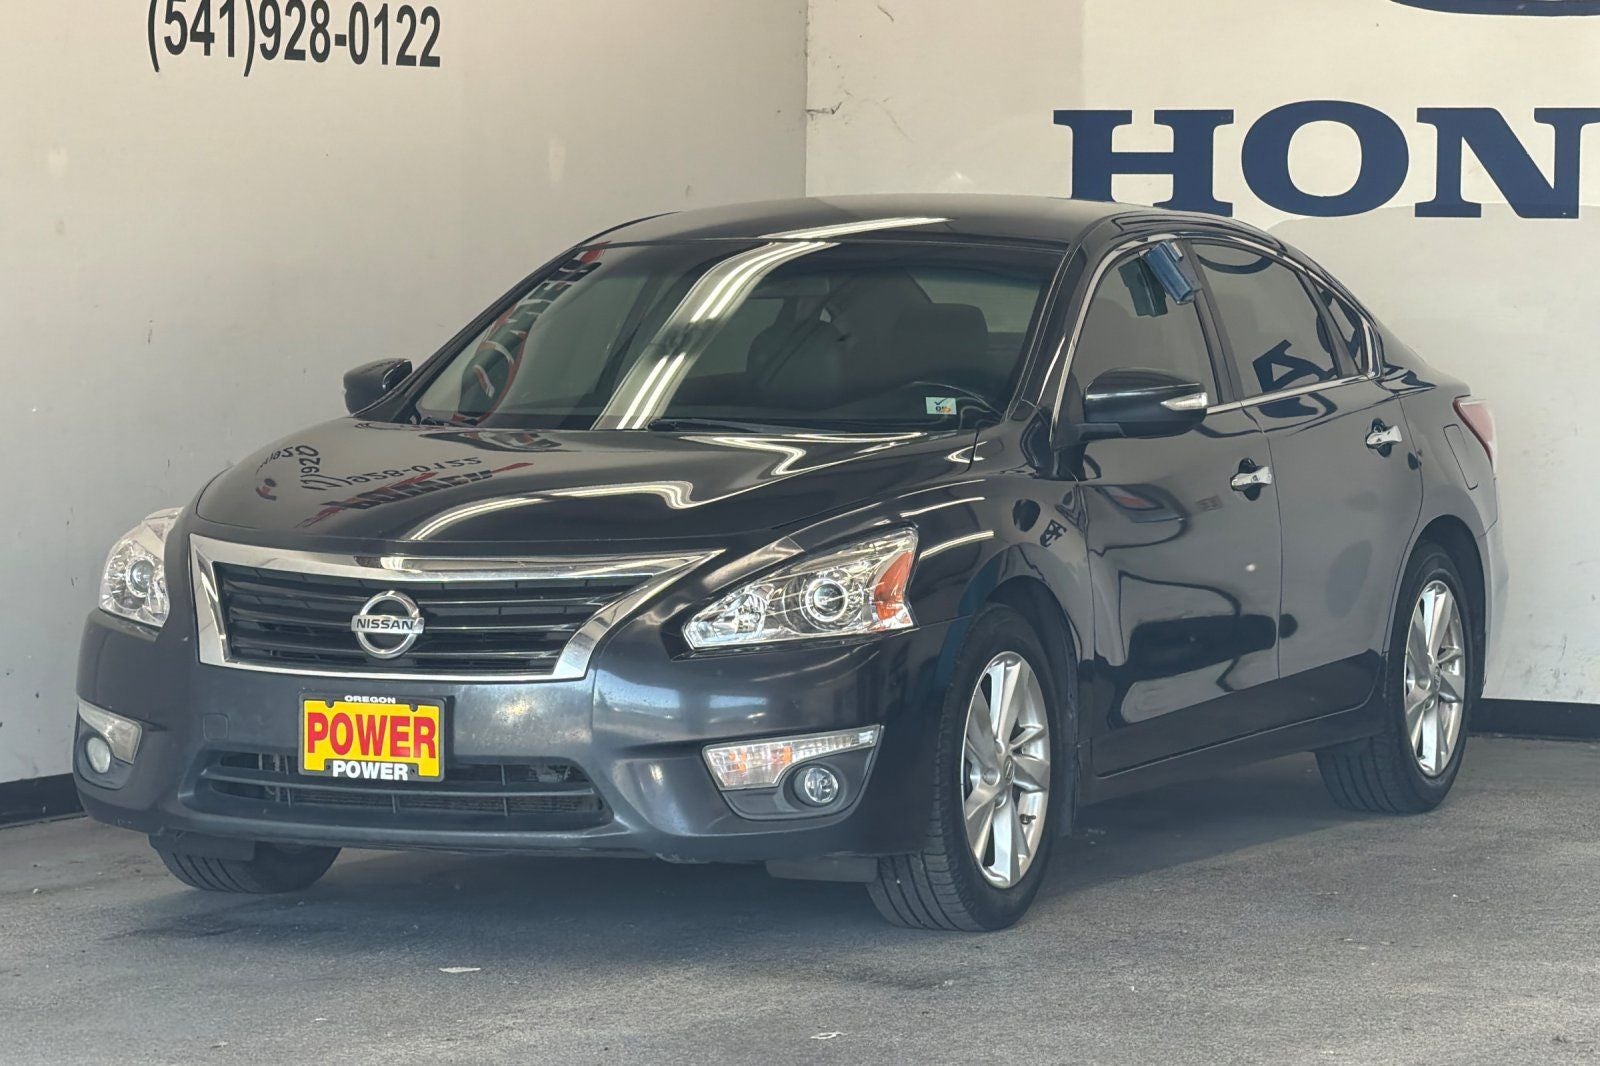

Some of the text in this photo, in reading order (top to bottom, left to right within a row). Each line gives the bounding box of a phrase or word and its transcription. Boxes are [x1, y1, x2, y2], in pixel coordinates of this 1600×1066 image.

[148, 0, 441, 77] (541)928-0122
[356, 618, 414, 630] NISSAN
[344, 695, 396, 704] OREGON
[307, 712, 436, 759] POWER
[332, 760, 408, 781] POWER
